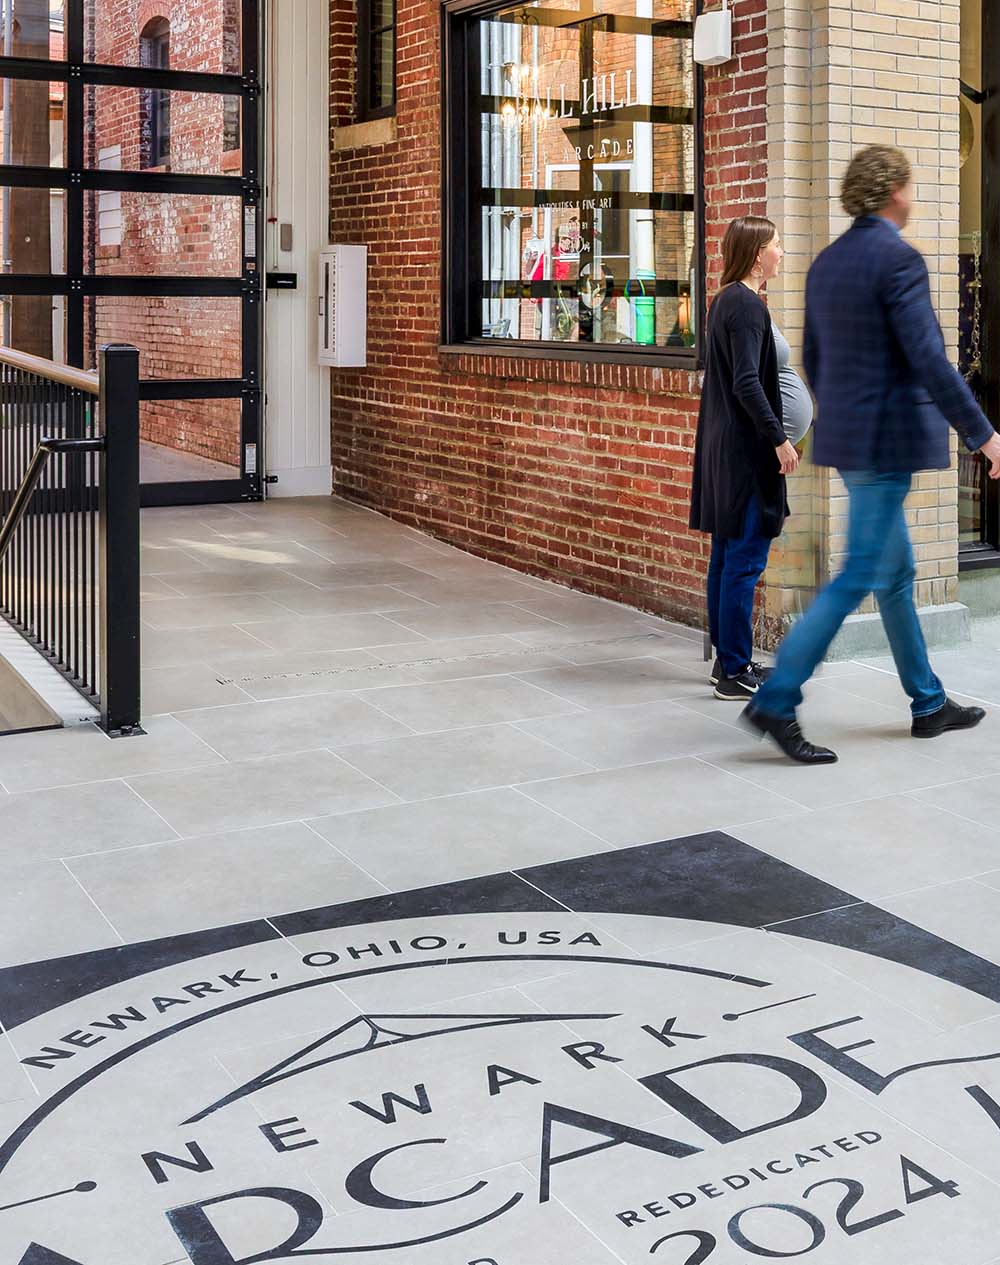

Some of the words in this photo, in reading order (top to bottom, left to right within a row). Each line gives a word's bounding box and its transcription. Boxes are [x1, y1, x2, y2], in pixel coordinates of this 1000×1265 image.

[582, 69, 639, 115] HILL
[562, 139, 633, 162] ARCADE
[582, 198, 596, 210] FINE
[599, 197, 612, 209] ART
[20, 968, 279, 1069] NEWARK,
[302, 936, 467, 966] OHIO,
[498, 932, 602, 946] USA
[141, 1016, 706, 1184] NEWARK
[616, 1130, 883, 1227] REDEDICATED
[649, 1154, 961, 1265] 2024
